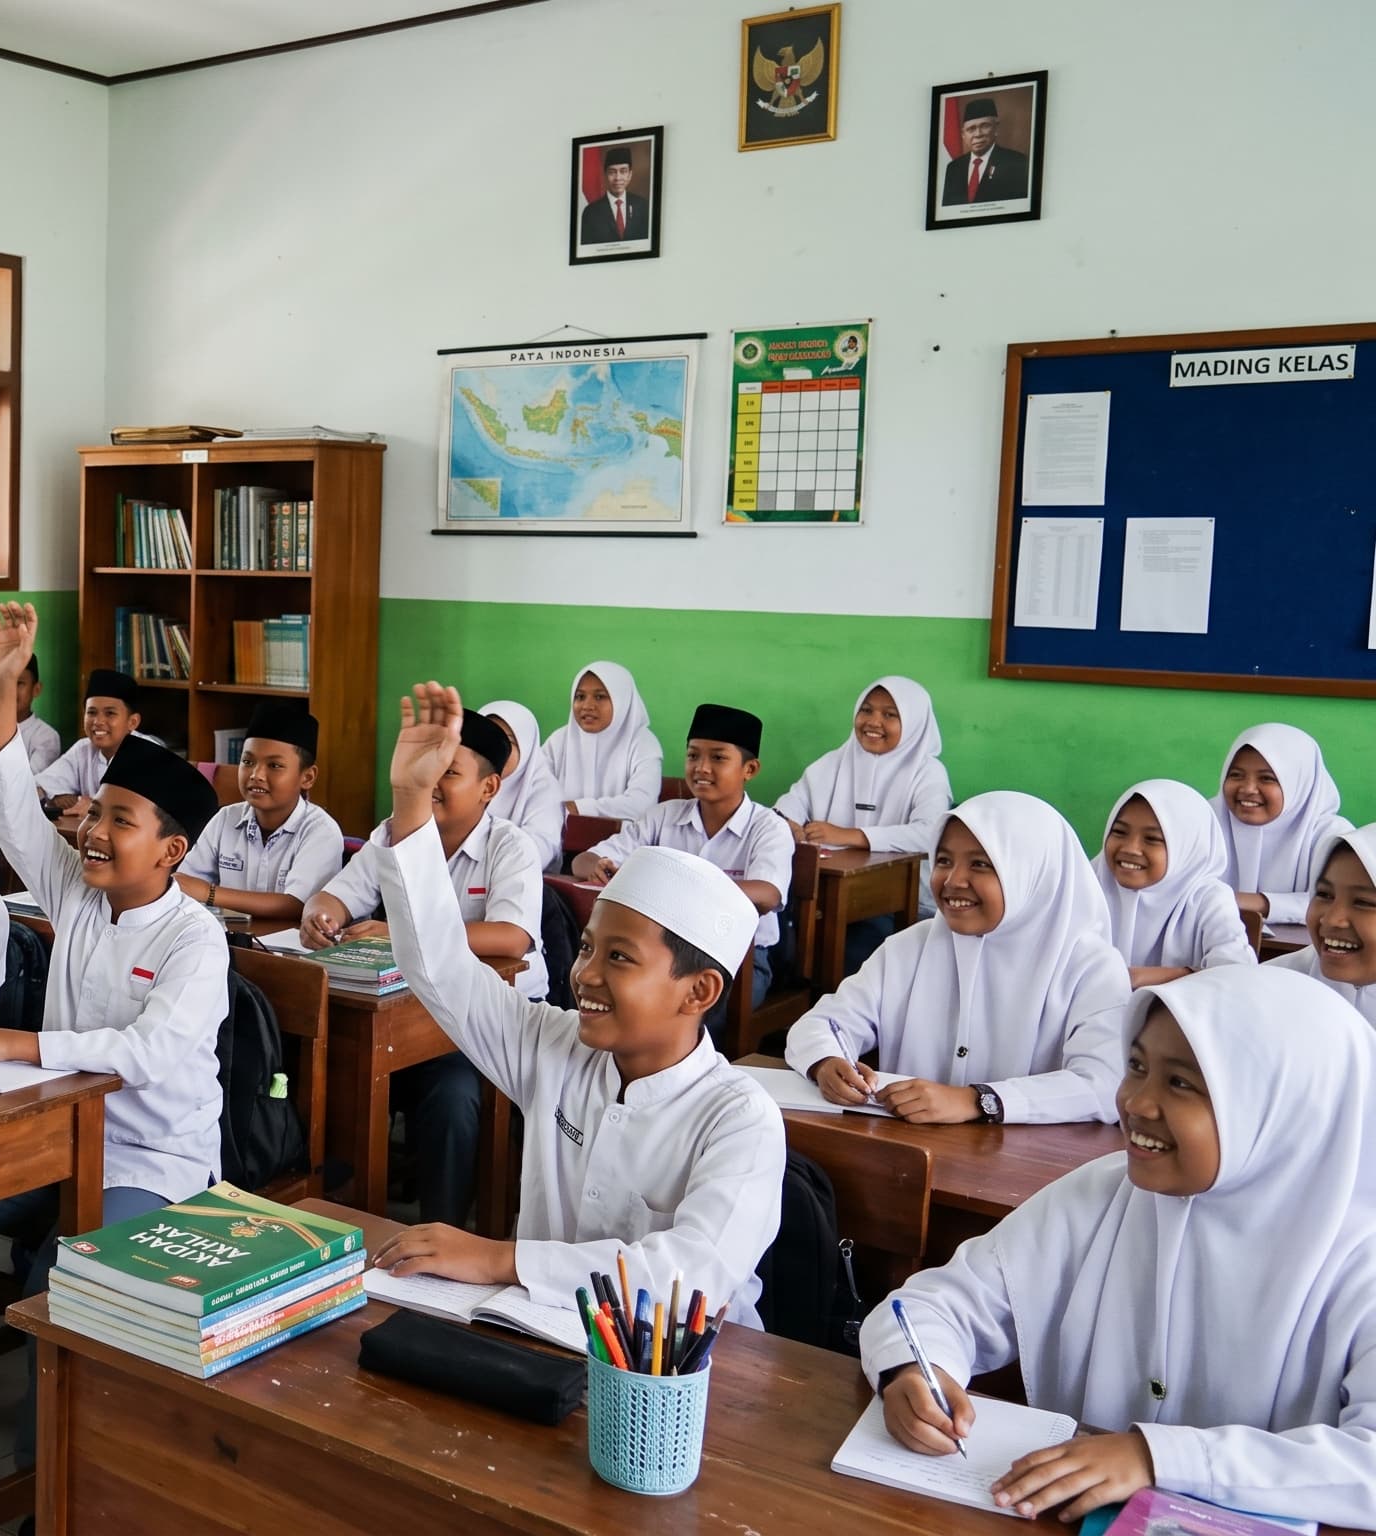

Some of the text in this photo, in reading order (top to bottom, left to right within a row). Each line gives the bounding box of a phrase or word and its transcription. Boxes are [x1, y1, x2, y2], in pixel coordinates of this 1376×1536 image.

[510, 347, 626, 362] PATA INDONESIA
[1174, 353, 1349, 379] MADING KELAS
[129, 1232, 233, 1268] AKIDAH
[149, 1223, 252, 1259] AKHLAK
